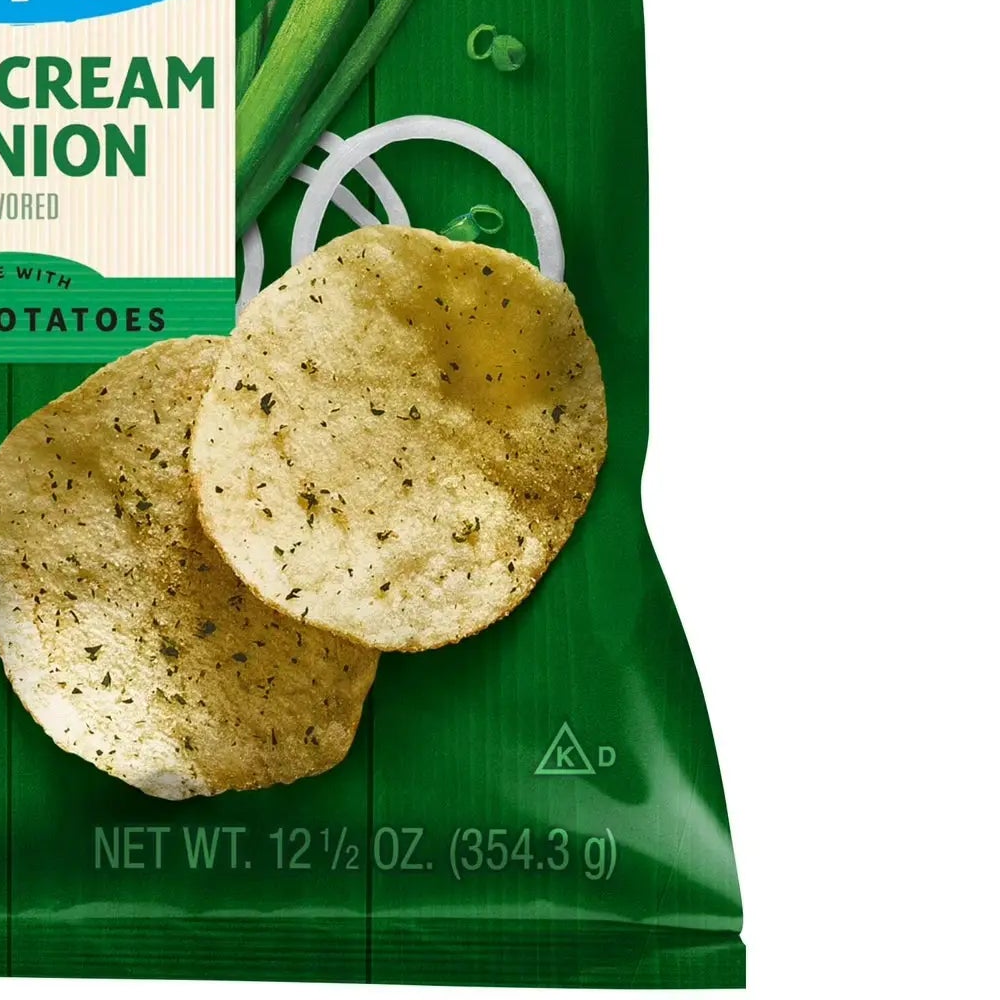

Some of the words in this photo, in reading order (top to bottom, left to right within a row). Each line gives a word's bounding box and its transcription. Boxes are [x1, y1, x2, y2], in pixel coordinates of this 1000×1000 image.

[15, 266, 73, 291] WITH
[598, 747, 617, 767] D
[93, 826, 172, 870] NET
[182, 826, 253, 870] WT.
[373, 826, 435, 870] OZ.
[449, 826, 570, 880] (354.3
[583, 828, 618, 881] g)
